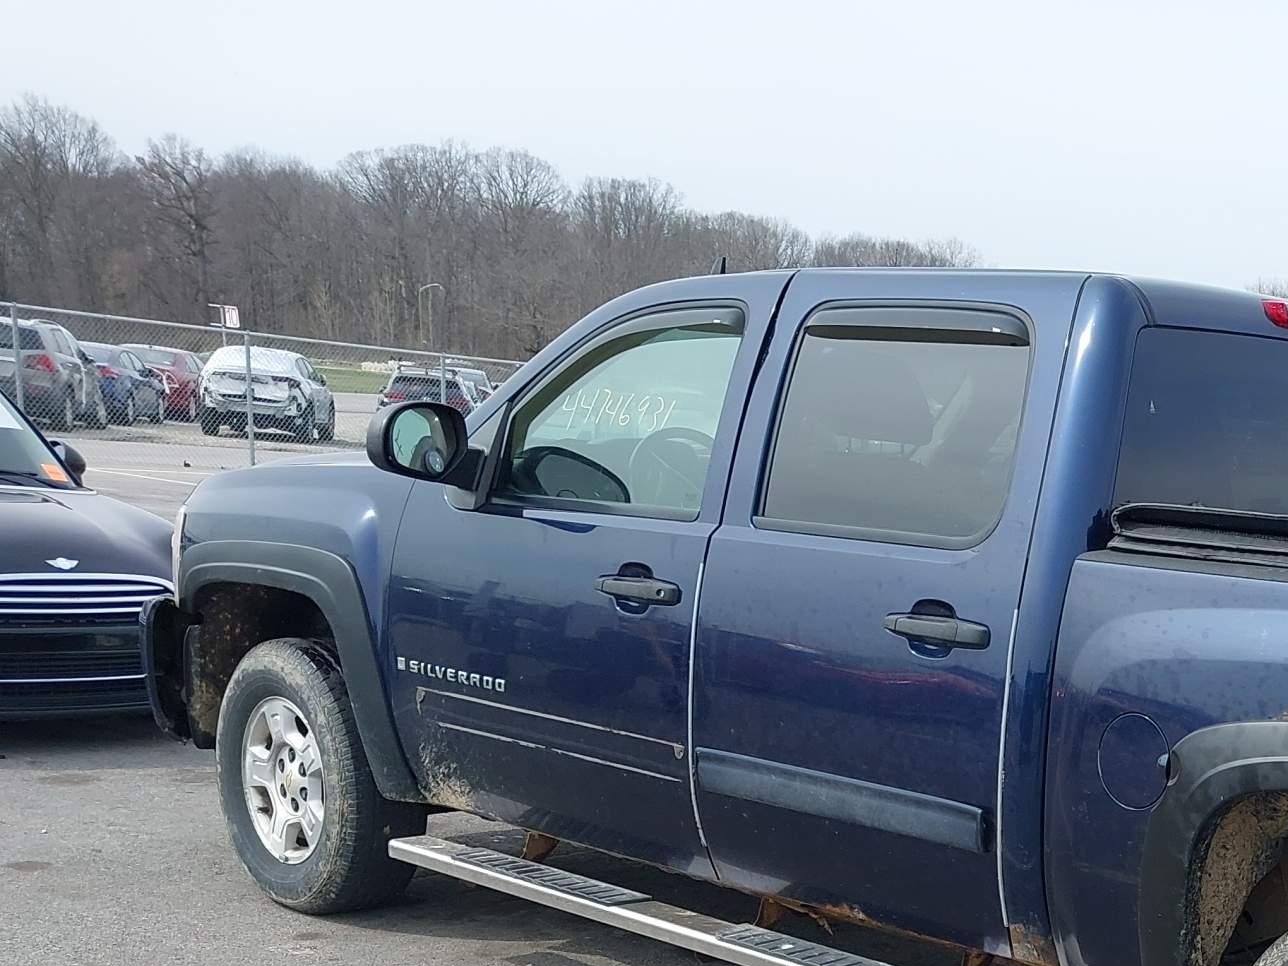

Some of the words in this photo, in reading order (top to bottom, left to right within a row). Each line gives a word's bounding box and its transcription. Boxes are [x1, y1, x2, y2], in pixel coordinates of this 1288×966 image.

[226, 308, 238, 326] 10
[561, 388, 676, 432] 44746931
[408, 659, 506, 693] SILVERADO
